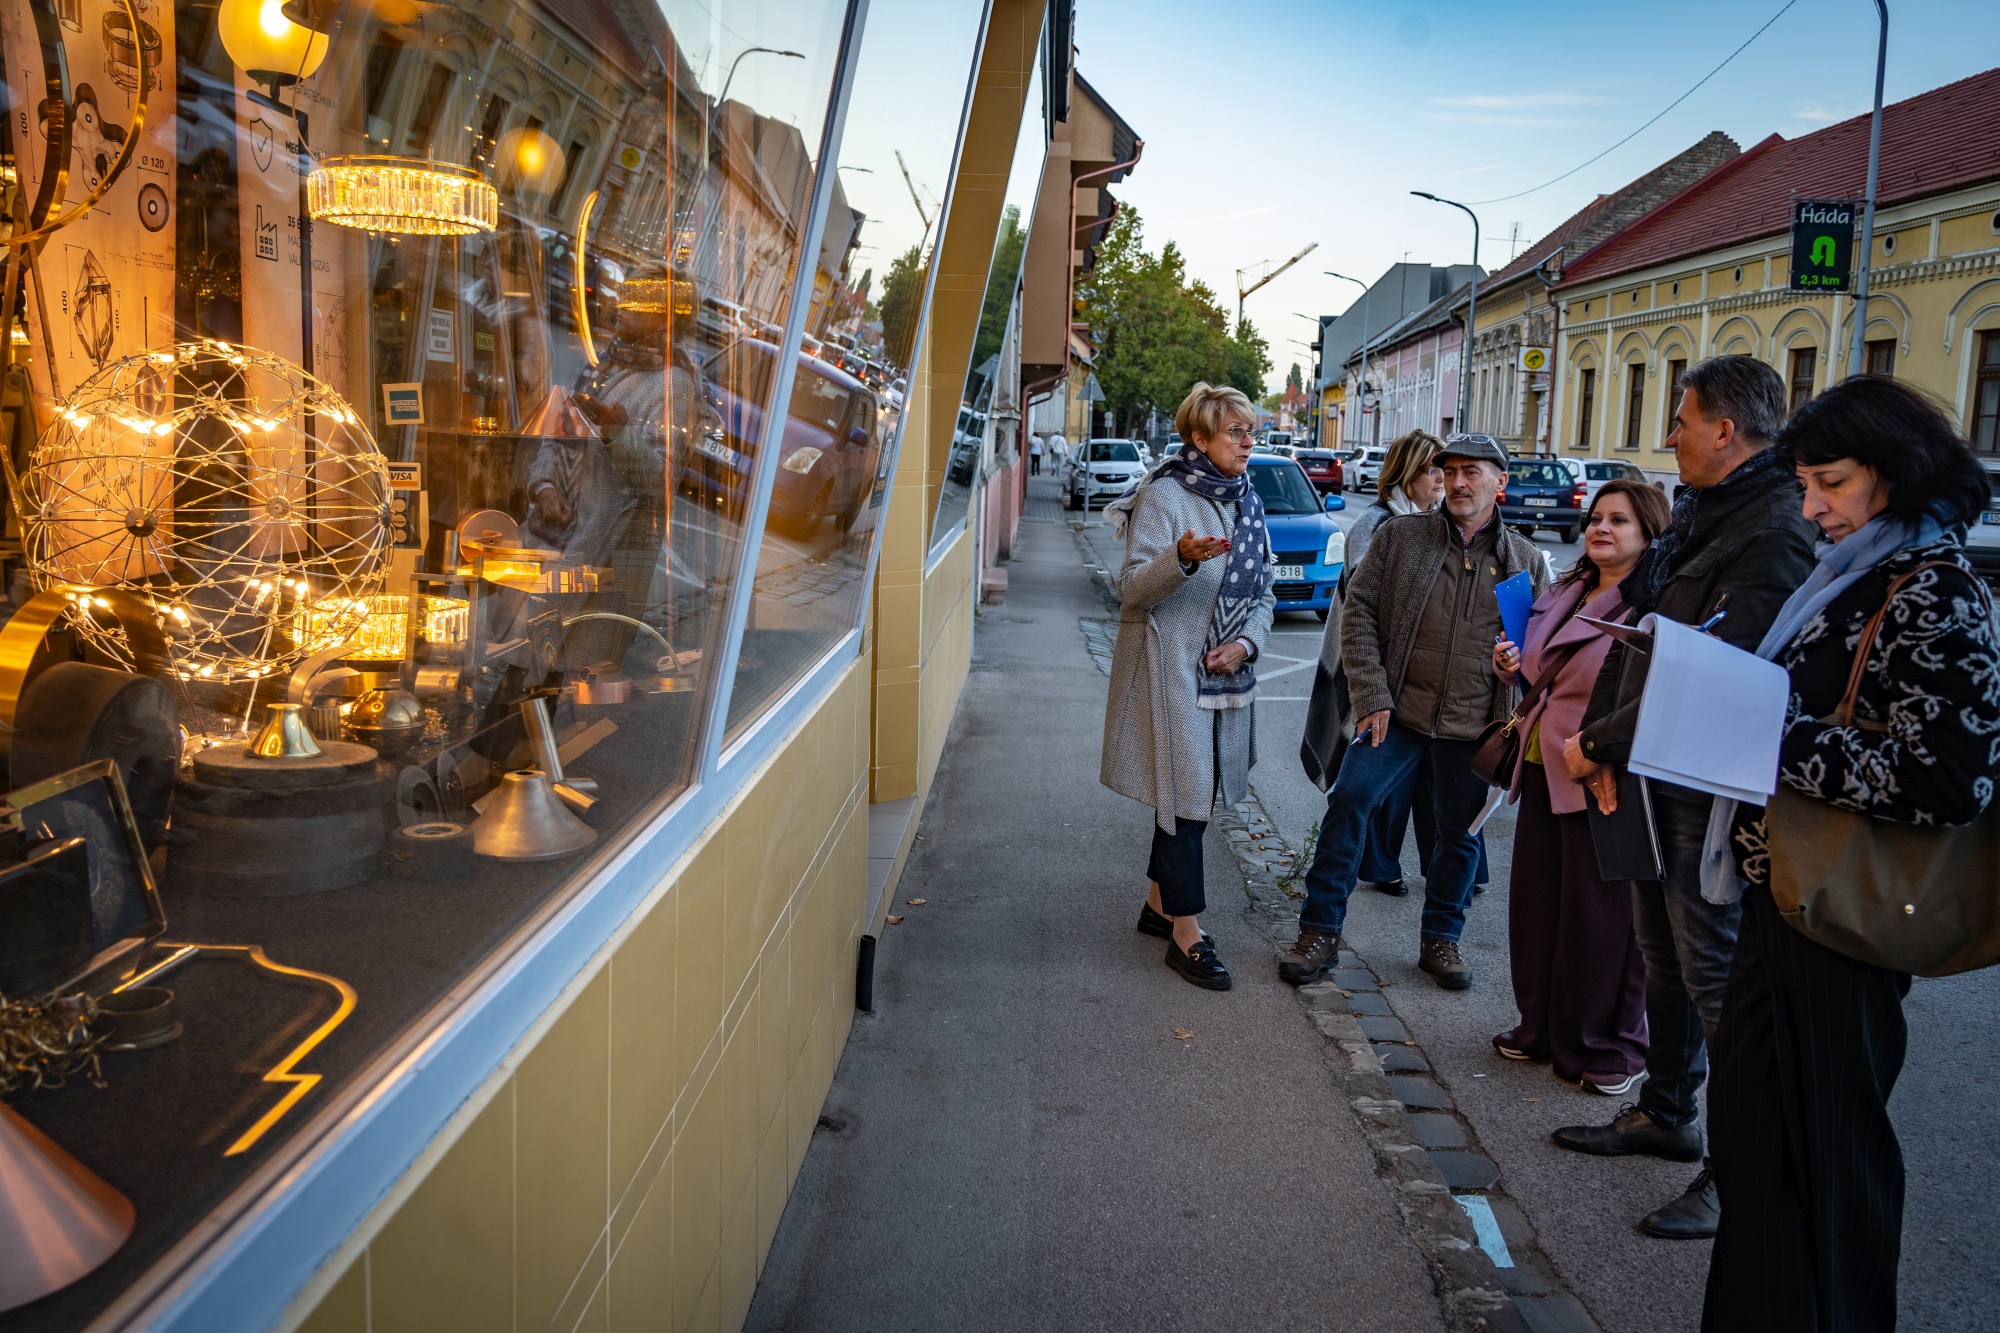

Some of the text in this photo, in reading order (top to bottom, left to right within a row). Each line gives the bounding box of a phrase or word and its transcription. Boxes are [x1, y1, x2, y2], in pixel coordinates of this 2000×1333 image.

[20, 112, 28, 138] 400
[151, 157, 165, 169] 120
[287, 215, 314, 233] 35 ÉS
[1800, 207, 1850, 224] Háda
[287, 234, 314, 251] MAGR
[287, 252, 330, 272] VÁLKOZÁS
[1800, 274, 1840, 286] 2,3 km
[148, 438, 157, 447] 250
[390, 472, 412, 481] VISA
